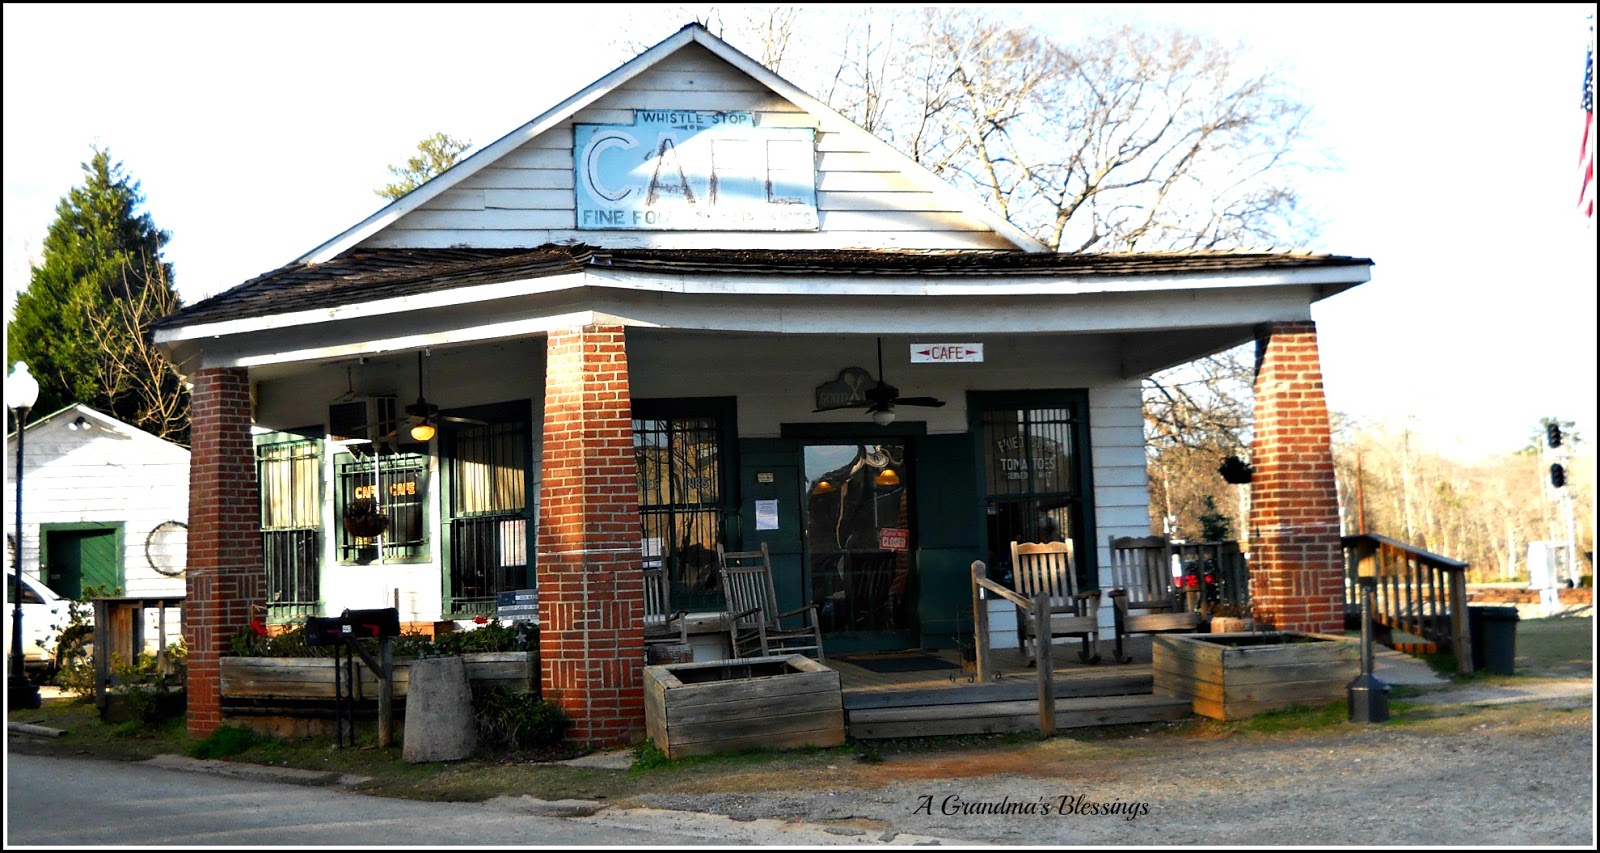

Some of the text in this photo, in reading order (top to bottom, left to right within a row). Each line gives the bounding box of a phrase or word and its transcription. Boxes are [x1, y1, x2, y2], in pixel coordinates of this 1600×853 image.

[643, 112, 747, 125] WHISTLE STOP
[580, 130, 812, 208] CAFE
[583, 210, 626, 225] FINE
[931, 346, 964, 360] CAFE
[1000, 458, 1056, 471] TOMATOES
[390, 481, 416, 497] CAFE
[637, 479, 660, 490] PES
[685, 478, 710, 490] PIES
